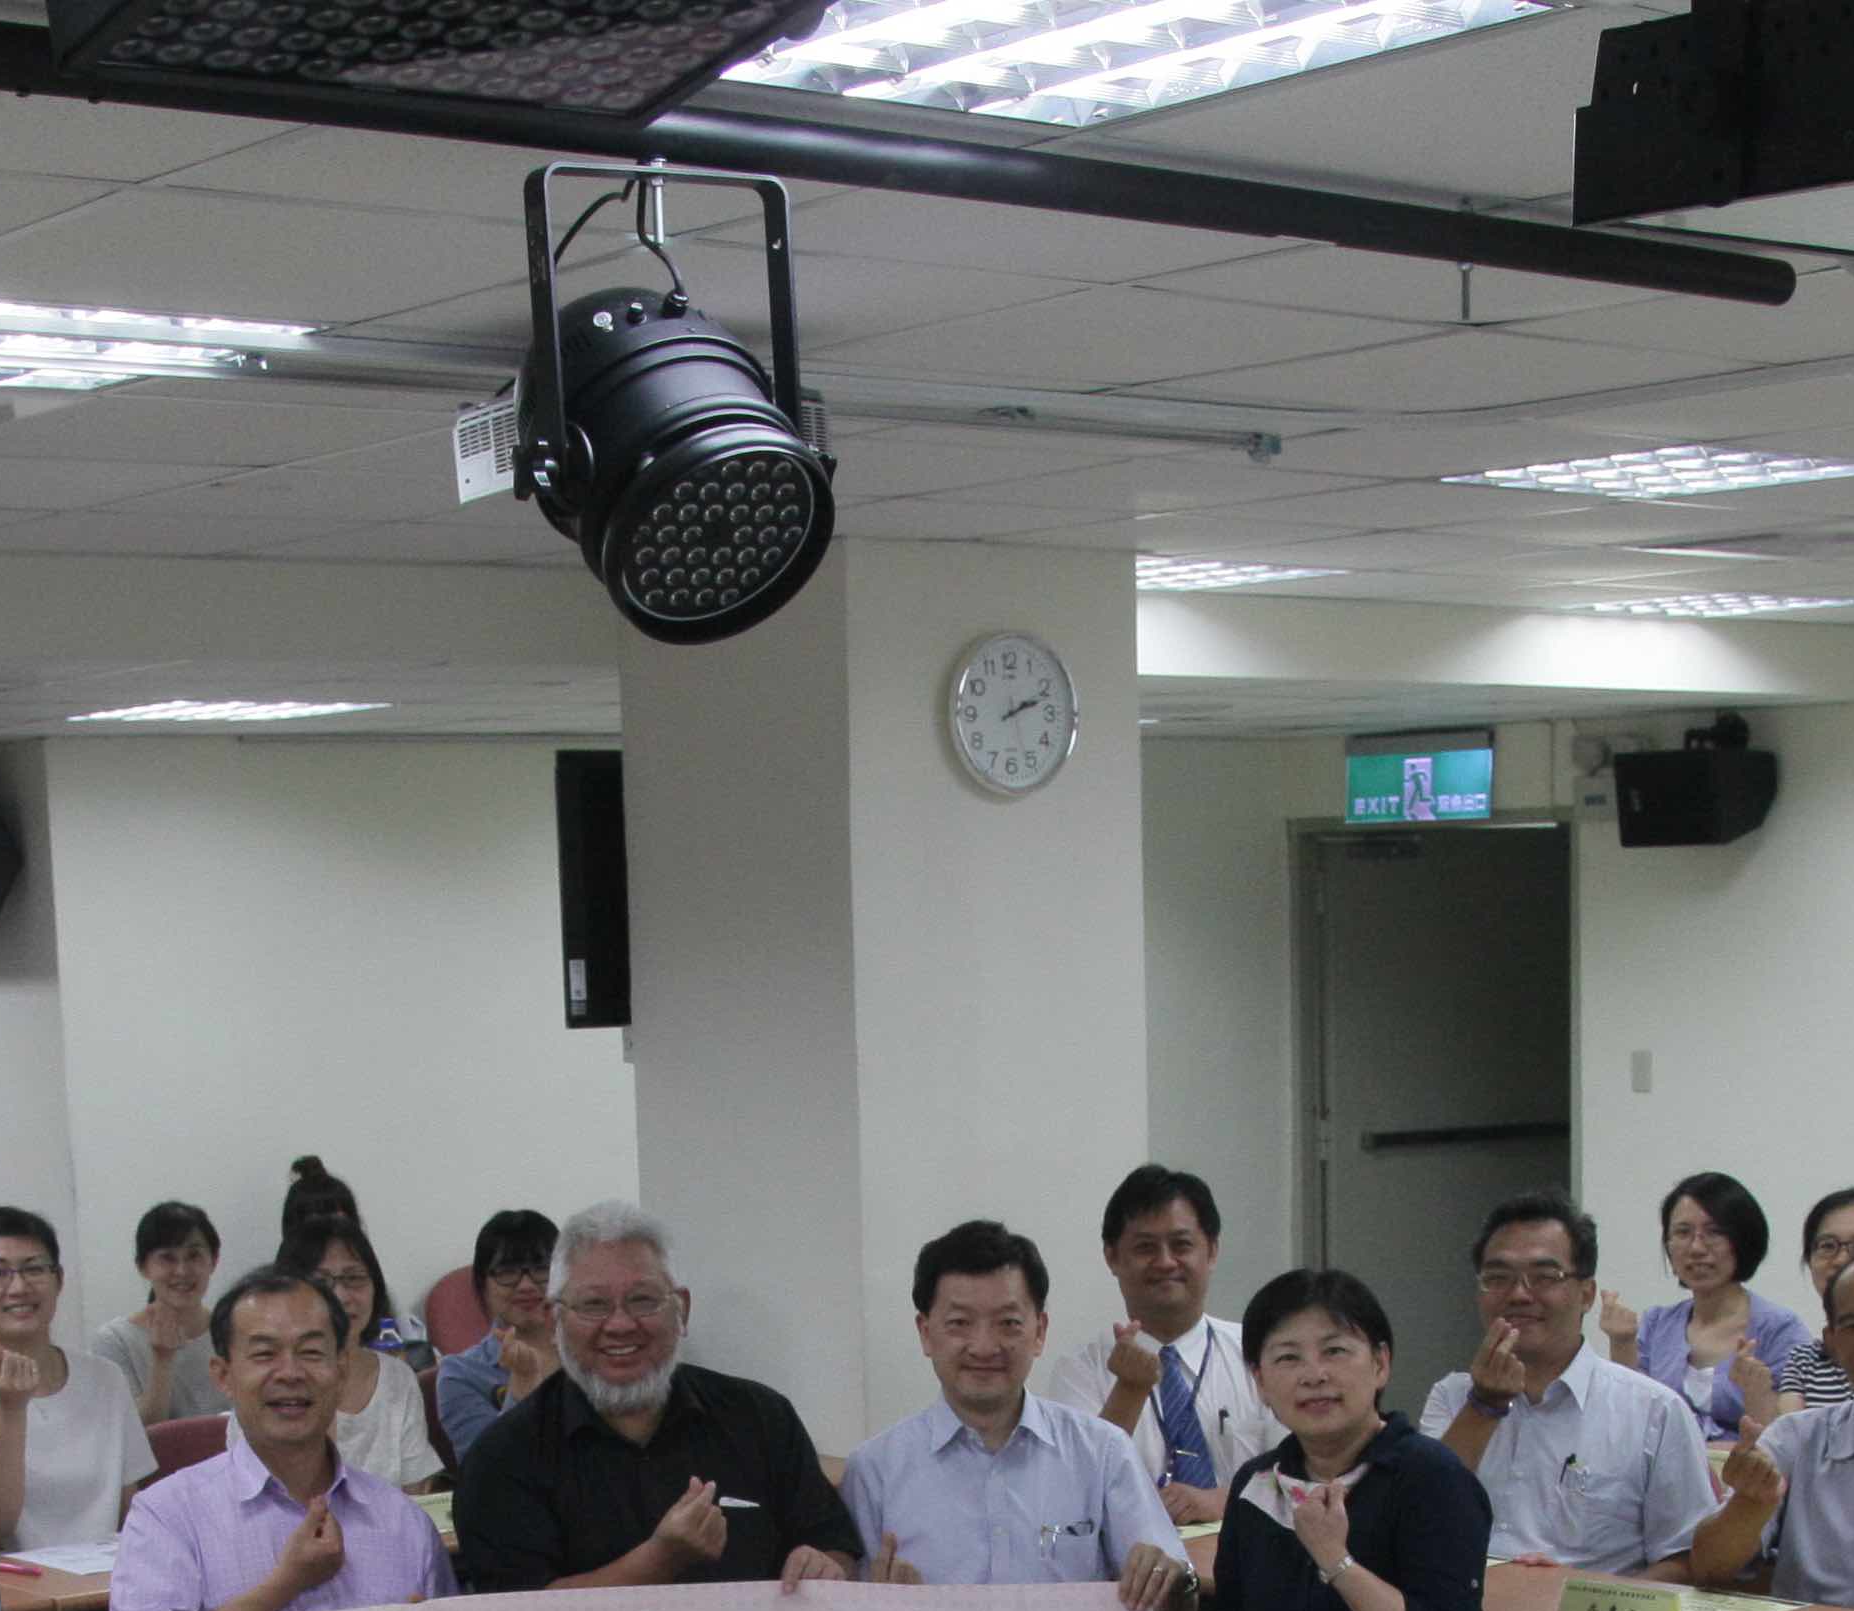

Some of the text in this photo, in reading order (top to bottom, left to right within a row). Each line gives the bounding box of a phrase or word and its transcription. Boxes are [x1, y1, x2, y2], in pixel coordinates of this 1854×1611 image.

[984, 660, 995, 675] 11
[1001, 652, 1017, 670] 12
[969, 679, 986, 696] 10
[1038, 679, 1050, 697] 2
[964, 705, 977, 722] 9
[1043, 705, 1056, 722] 3
[971, 732, 983, 749] 8
[1038, 731, 1050, 747] 4
[987, 751, 998, 768] 7
[1005, 757, 1018, 775] 6
[1025, 751, 1037, 768] 5
[1353, 796, 1401, 816] EXIT
